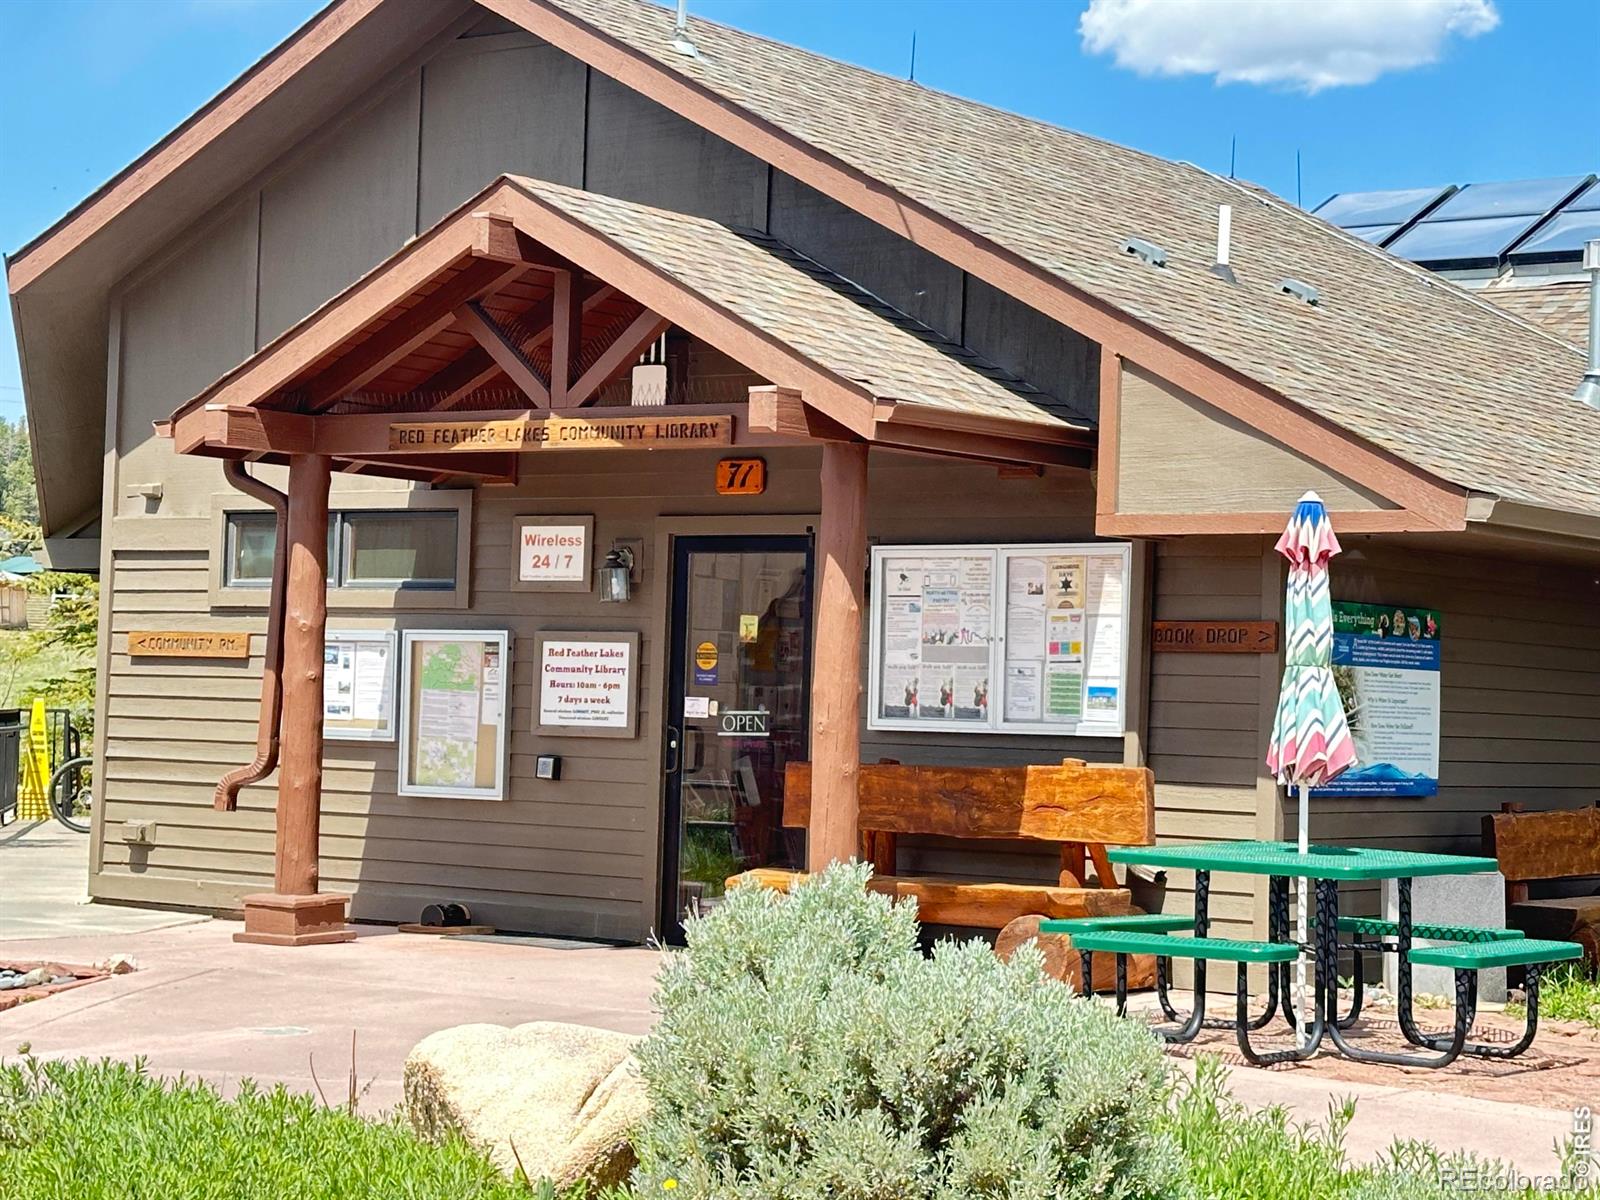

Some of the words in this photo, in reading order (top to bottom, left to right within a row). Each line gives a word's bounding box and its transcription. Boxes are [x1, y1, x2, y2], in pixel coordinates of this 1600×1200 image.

[399, 429, 425, 444] RED
[433, 428, 496, 444] FEATHER
[505, 427, 550, 442] LAKES
[559, 424, 646, 441] COMMUNITY
[655, 422, 719, 439] LIBRARY
[726, 462, 754, 489] 77
[524, 534, 583, 546] Wireless
[532, 554, 551, 569] 24
[564, 554, 573, 569] 7
[1339, 610, 1375, 628] Everything
[1154, 628, 1194, 644] BOOK
[1206, 627, 1248, 644] DROP
[148, 637, 213, 650] COMMUNITY
[548, 648, 565, 657] Red
[566, 648, 598, 658] Feather
[600, 648, 624, 658] Lakes
[544, 664, 593, 675] Community
[595, 664, 626, 676] Library
[549, 679, 576, 689] Hours:
[576, 681, 597, 689] 10am
[603, 682, 621, 691] 6pm
[558, 696, 563, 704] 7
[563, 695, 582, 705] days
[590, 696, 611, 704] week
[722, 714, 766, 732] OPEN
